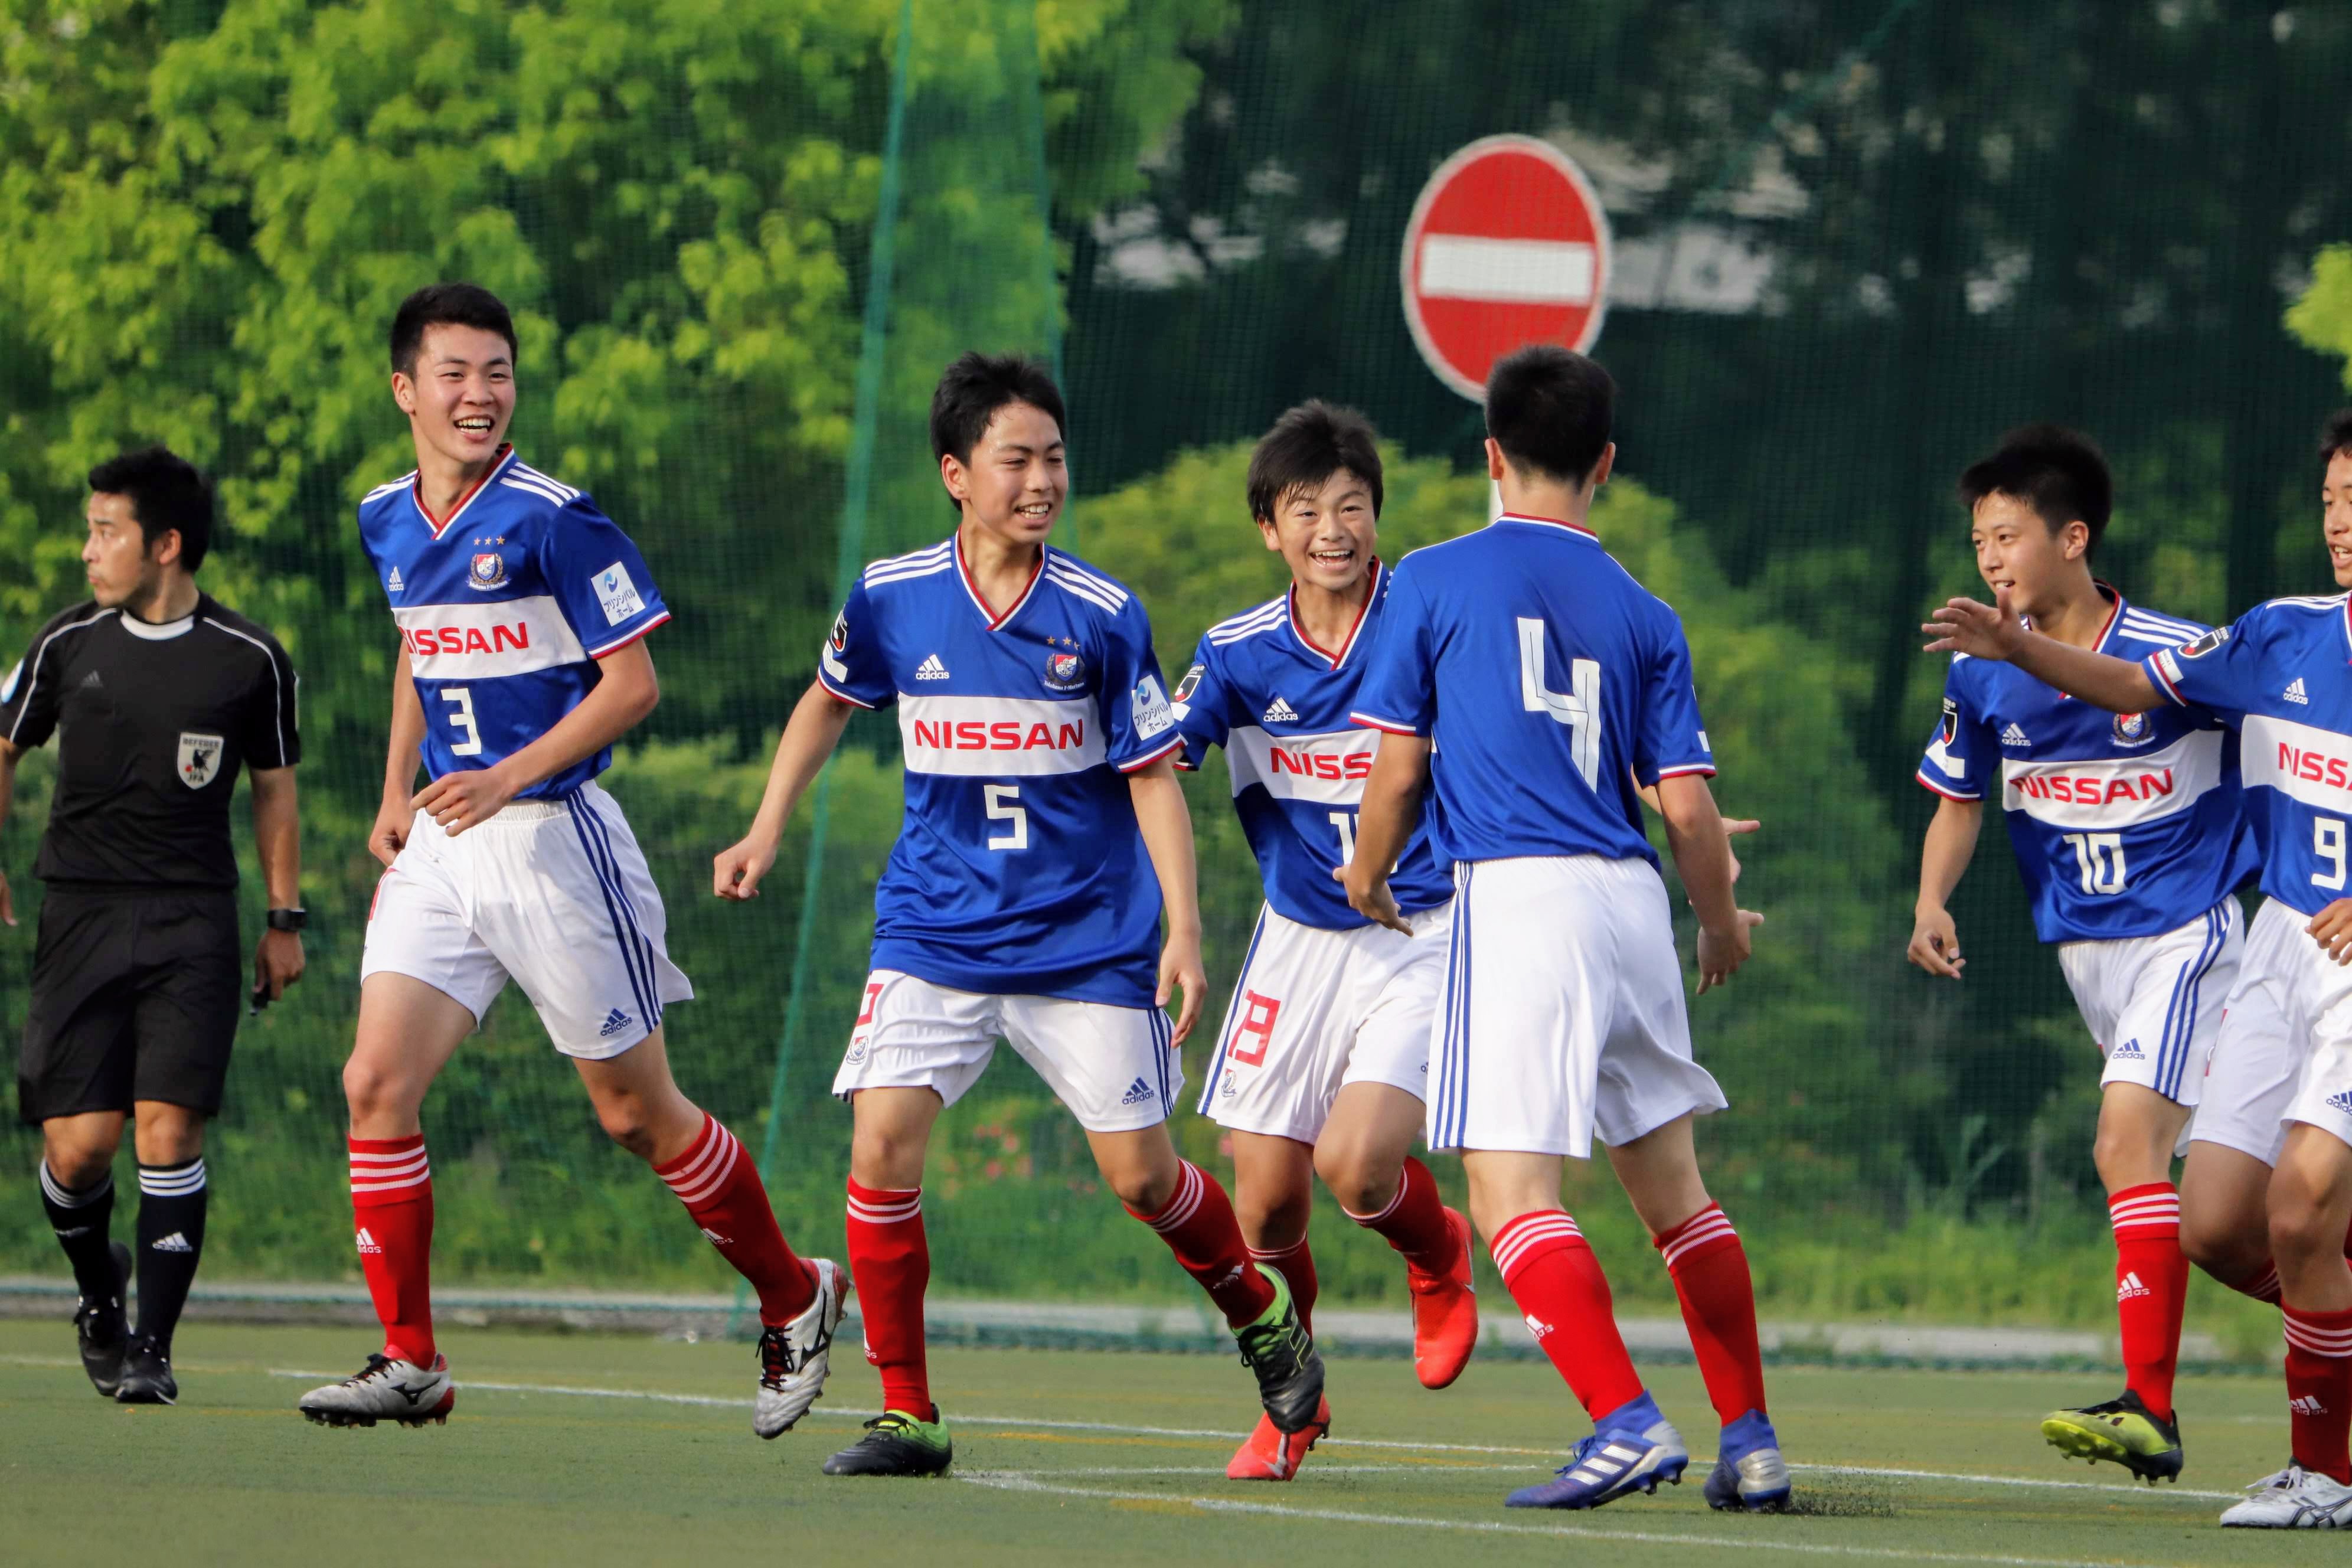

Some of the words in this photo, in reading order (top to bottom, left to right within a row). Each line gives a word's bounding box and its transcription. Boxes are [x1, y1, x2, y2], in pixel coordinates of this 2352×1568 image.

[616, 603, 635, 619] ホーム
[916, 670, 950, 681] adidas
[1517, 617, 1601, 794] 4
[2283, 692, 2309, 705] adidas
[440, 687, 482, 756] 3
[1147, 717, 1168, 733] ホーム
[1263, 713, 1299, 723] adidas
[914, 718, 1083, 750] NISSAN
[2001, 737, 2031, 747] adidas
[2279, 741, 2352, 791] NISS
[2008, 768, 2173, 805] NISSAN
[984, 784, 1027, 850] 5
[2311, 816, 2346, 891] 9
[2062, 833, 2128, 895] 10
[600, 1017, 632, 1036] adidas
[2113, 1051, 2145, 1060] adidas
[1122, 1090, 1154, 1105] adidas
